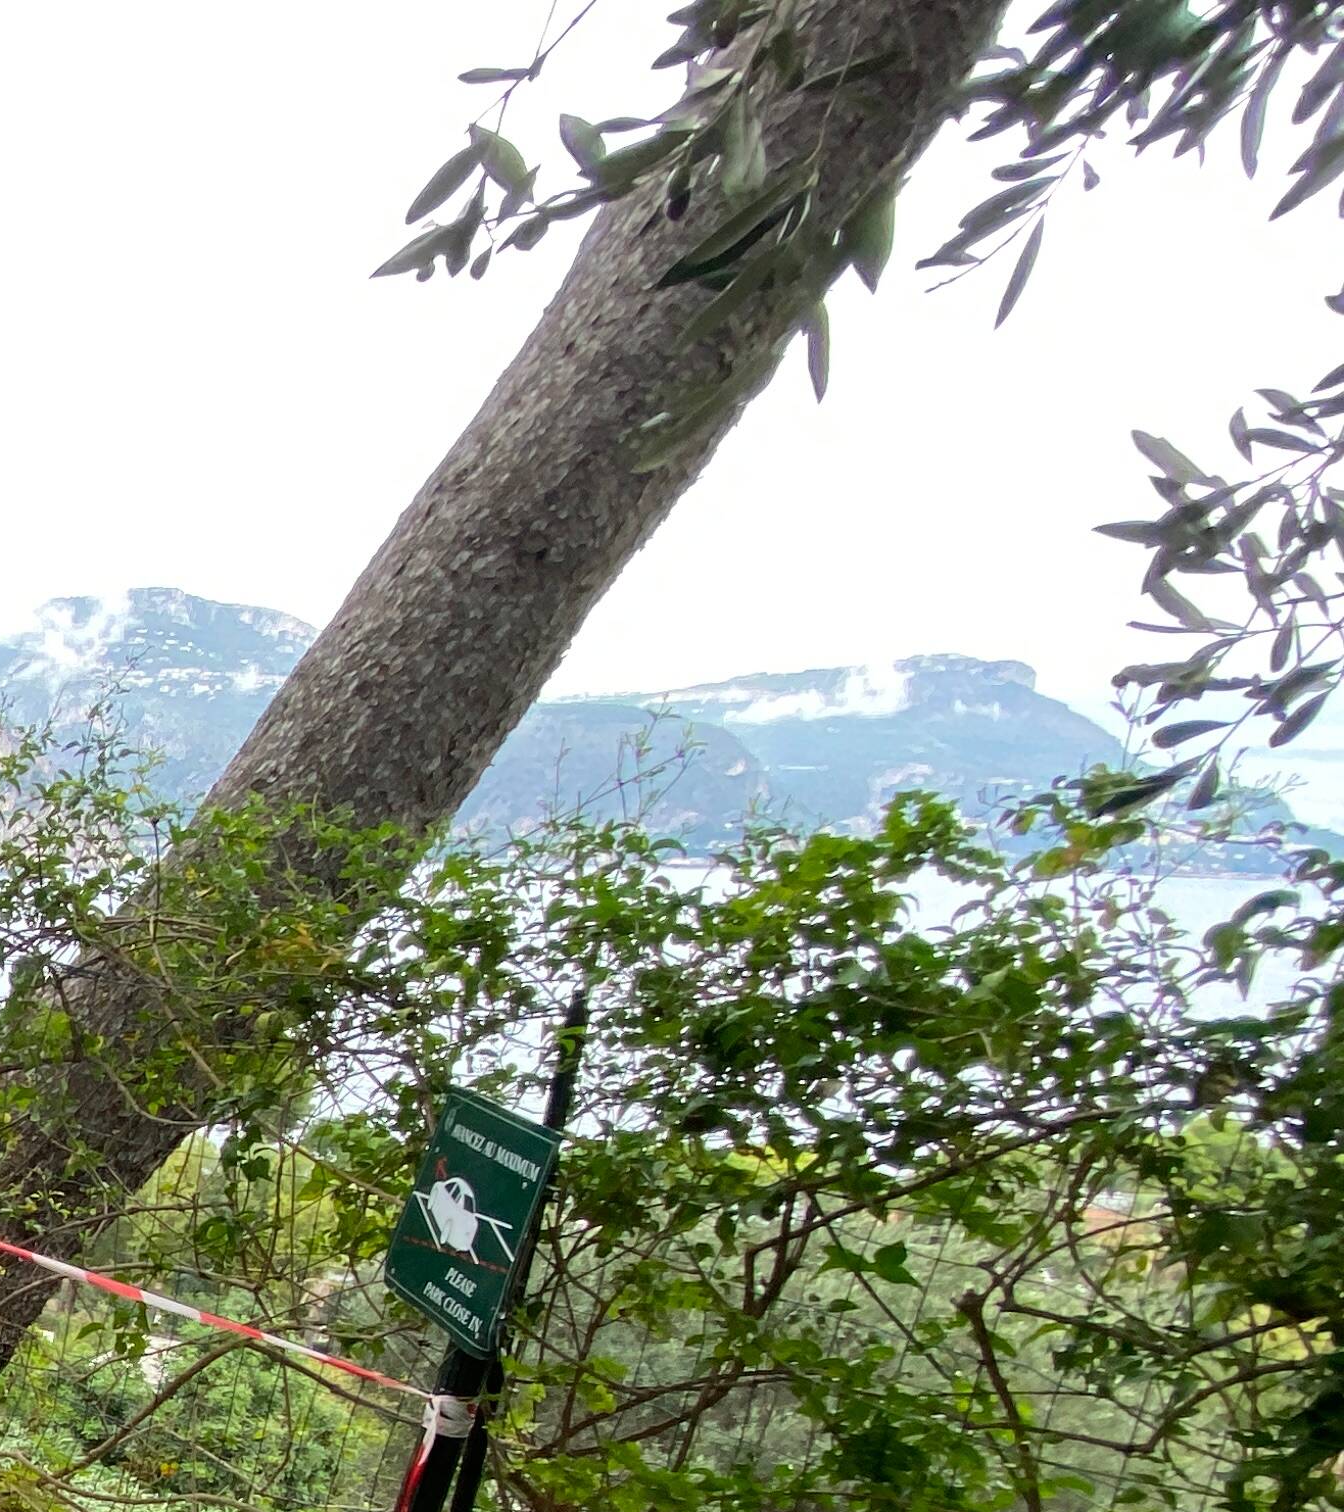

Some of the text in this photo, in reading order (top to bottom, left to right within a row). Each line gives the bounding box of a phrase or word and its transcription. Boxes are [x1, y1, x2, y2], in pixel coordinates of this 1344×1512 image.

[451, 1124, 541, 1182] AVANCEZ AU MAXIMUM
[423, 1281, 483, 1333] PARK CLOSE IN
[444, 1267, 477, 1298] PLEASE
